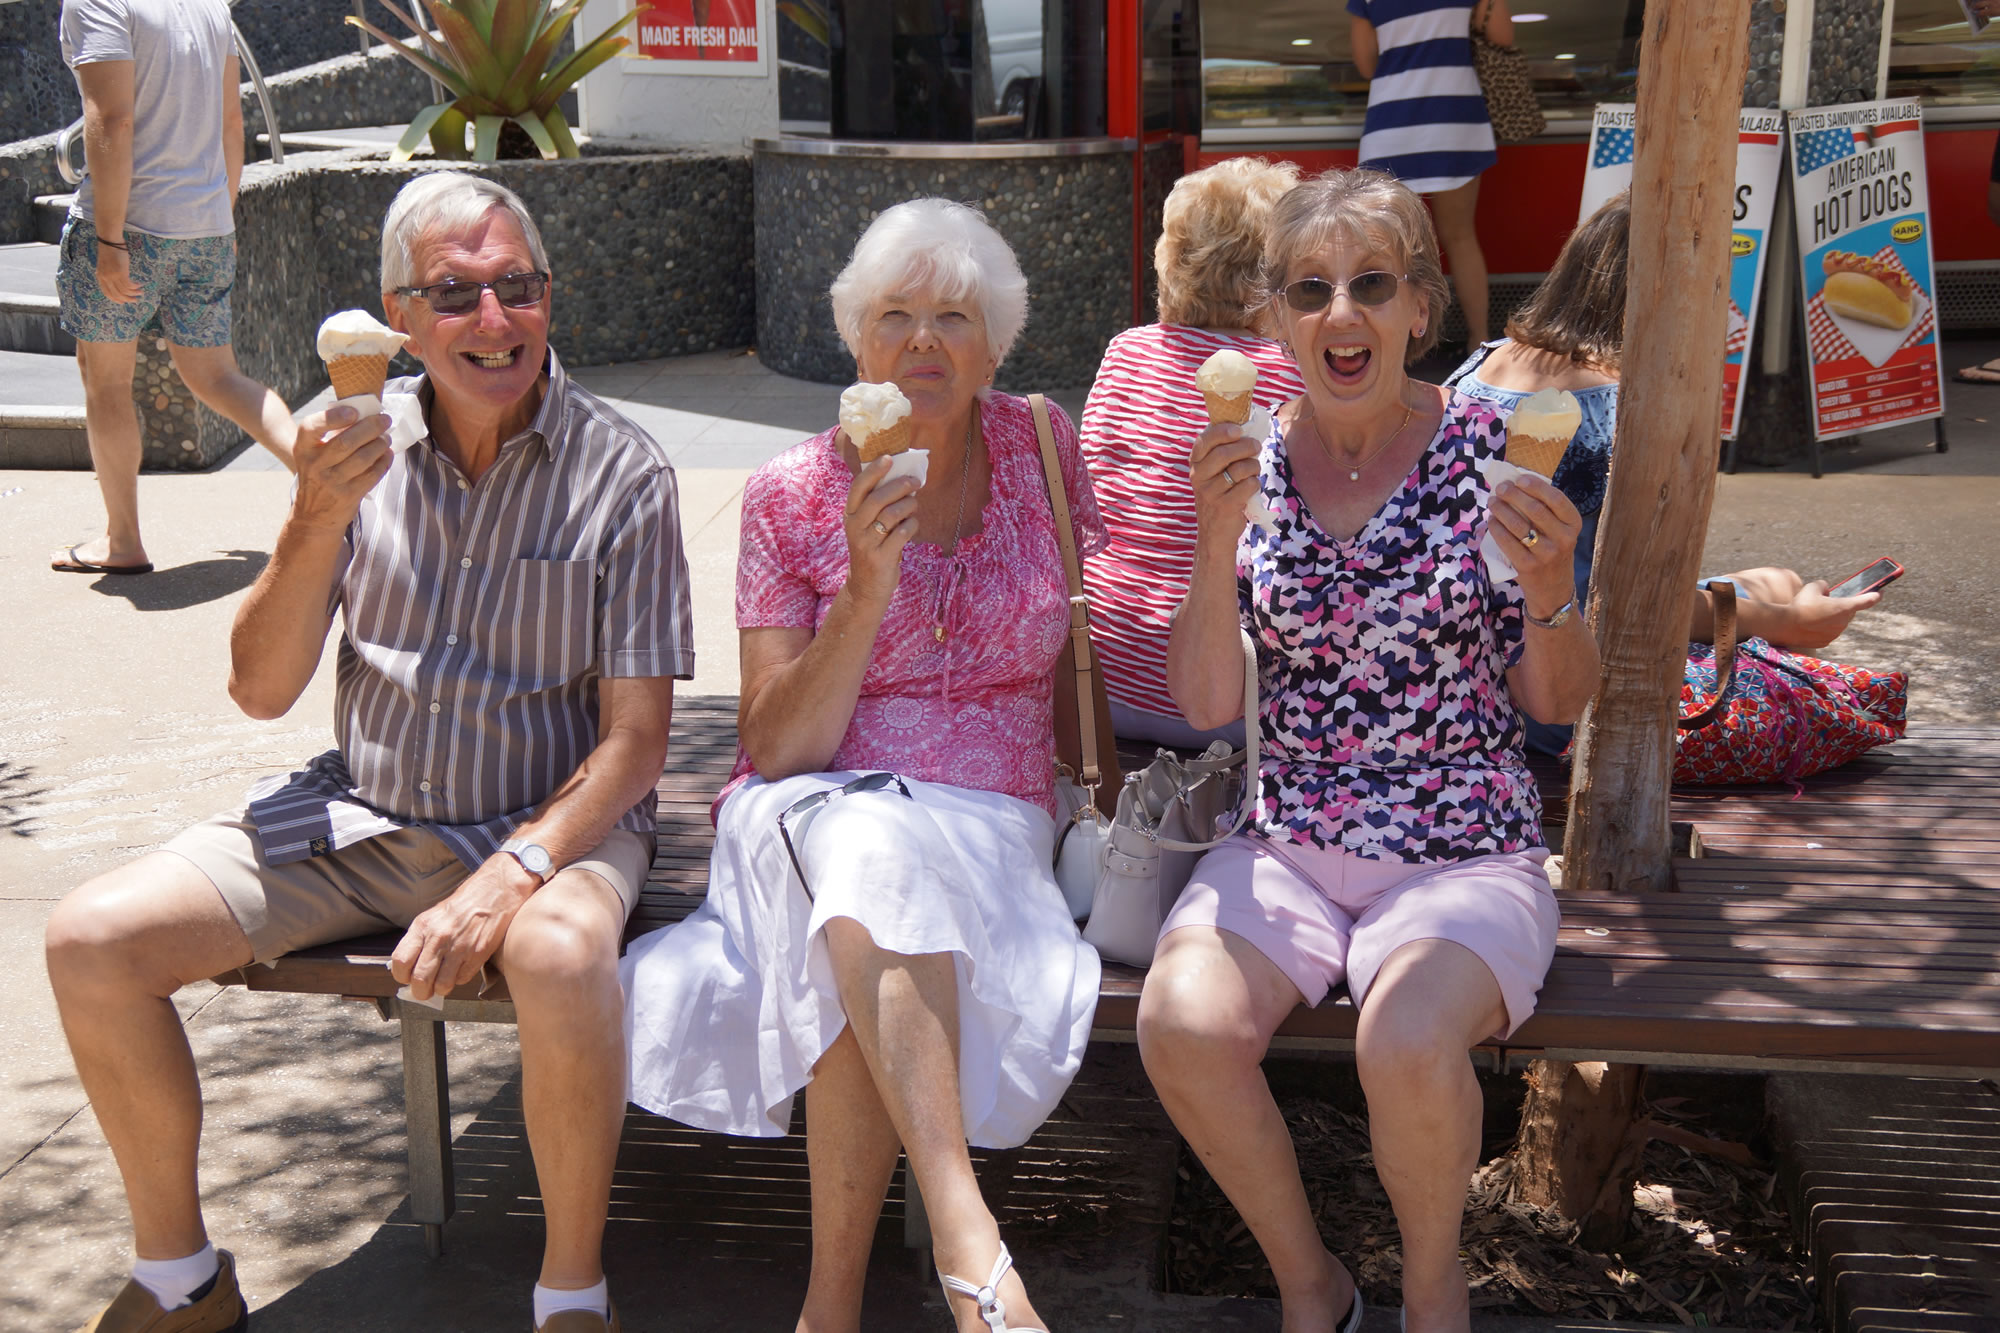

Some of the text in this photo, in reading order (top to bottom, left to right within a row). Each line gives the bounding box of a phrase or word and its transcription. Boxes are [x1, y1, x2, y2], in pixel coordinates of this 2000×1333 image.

[641, 26, 758, 47] MADE FRESH DAIL
[1596, 111, 1635, 126] TOASTE
[1789, 103, 1921, 132] TOASTED SANDWICHES AVAILABLE
[1827, 146, 1896, 194] AMERICAN
[1813, 188, 1854, 245] HOT
[1859, 170, 1913, 224] DOGS
[1893, 224, 1920, 236] HANS
